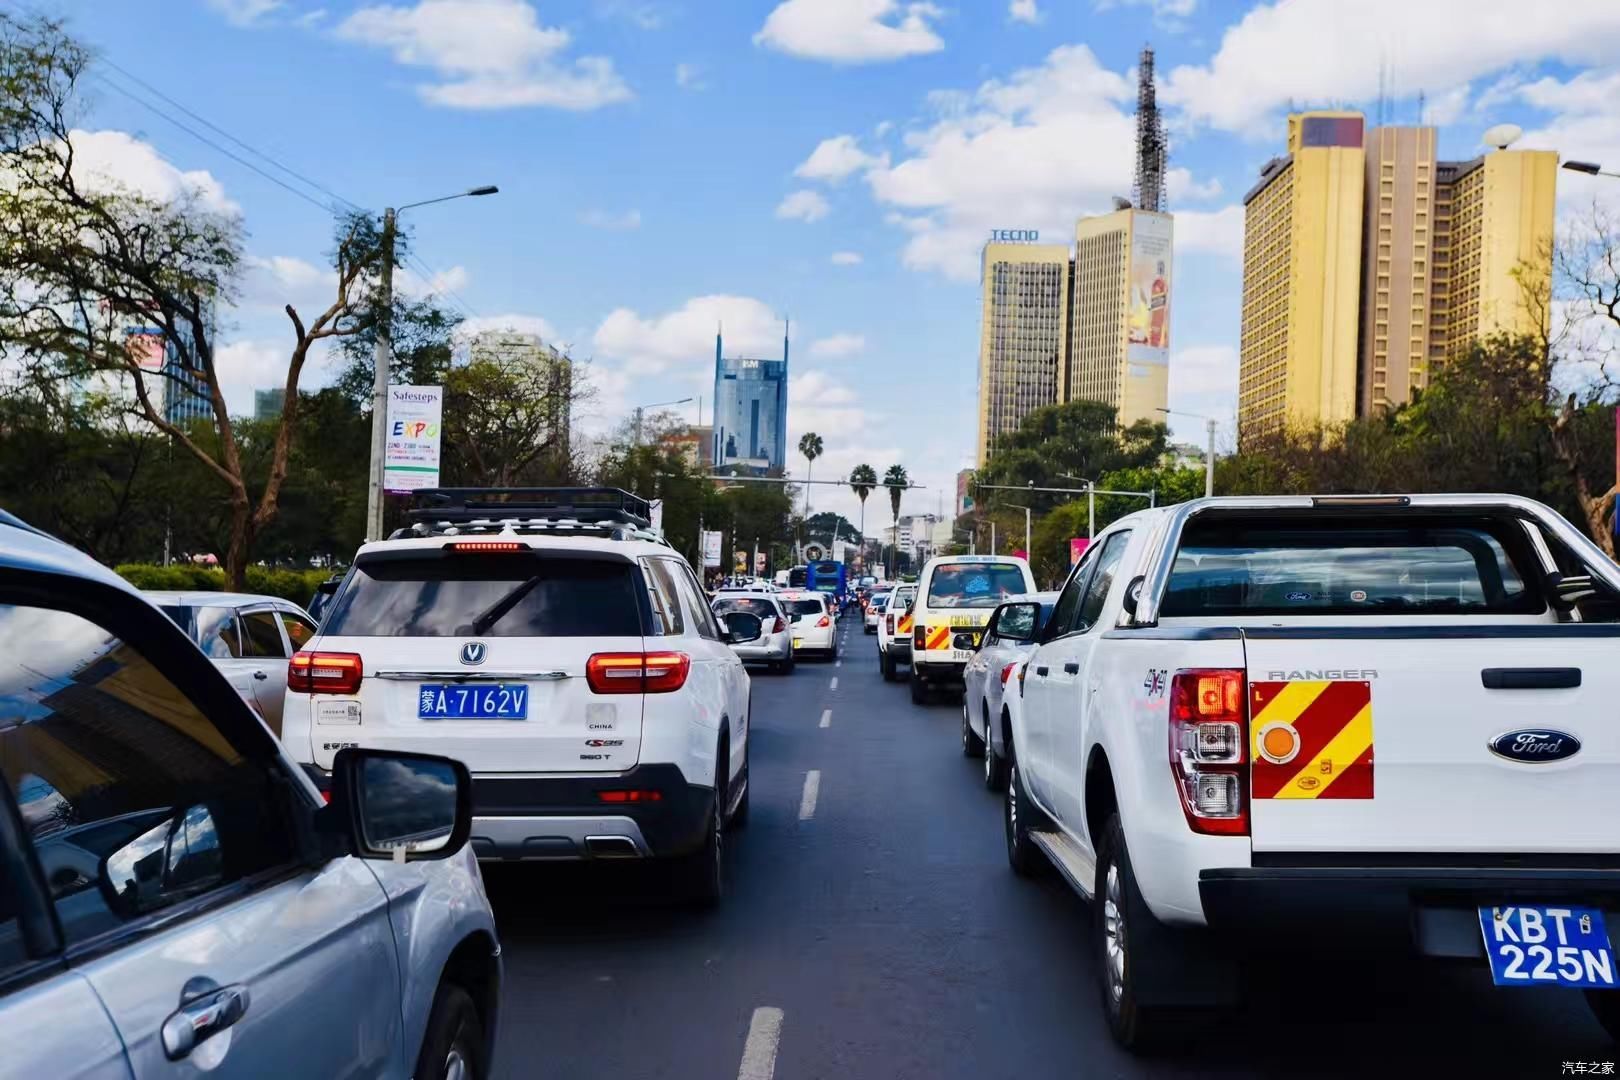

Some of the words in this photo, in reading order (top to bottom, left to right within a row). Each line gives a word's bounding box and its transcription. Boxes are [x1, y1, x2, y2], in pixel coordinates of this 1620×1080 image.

[992, 229, 1039, 241] TECNO
[393, 391, 438, 404] Safesteps
[392, 421, 438, 438] EXPO
[1267, 669, 1379, 681] RANGER
[1511, 733, 1563, 753] Ford
[1492, 906, 1571, 945] KBT
[1500, 944, 1614, 984] 225N
